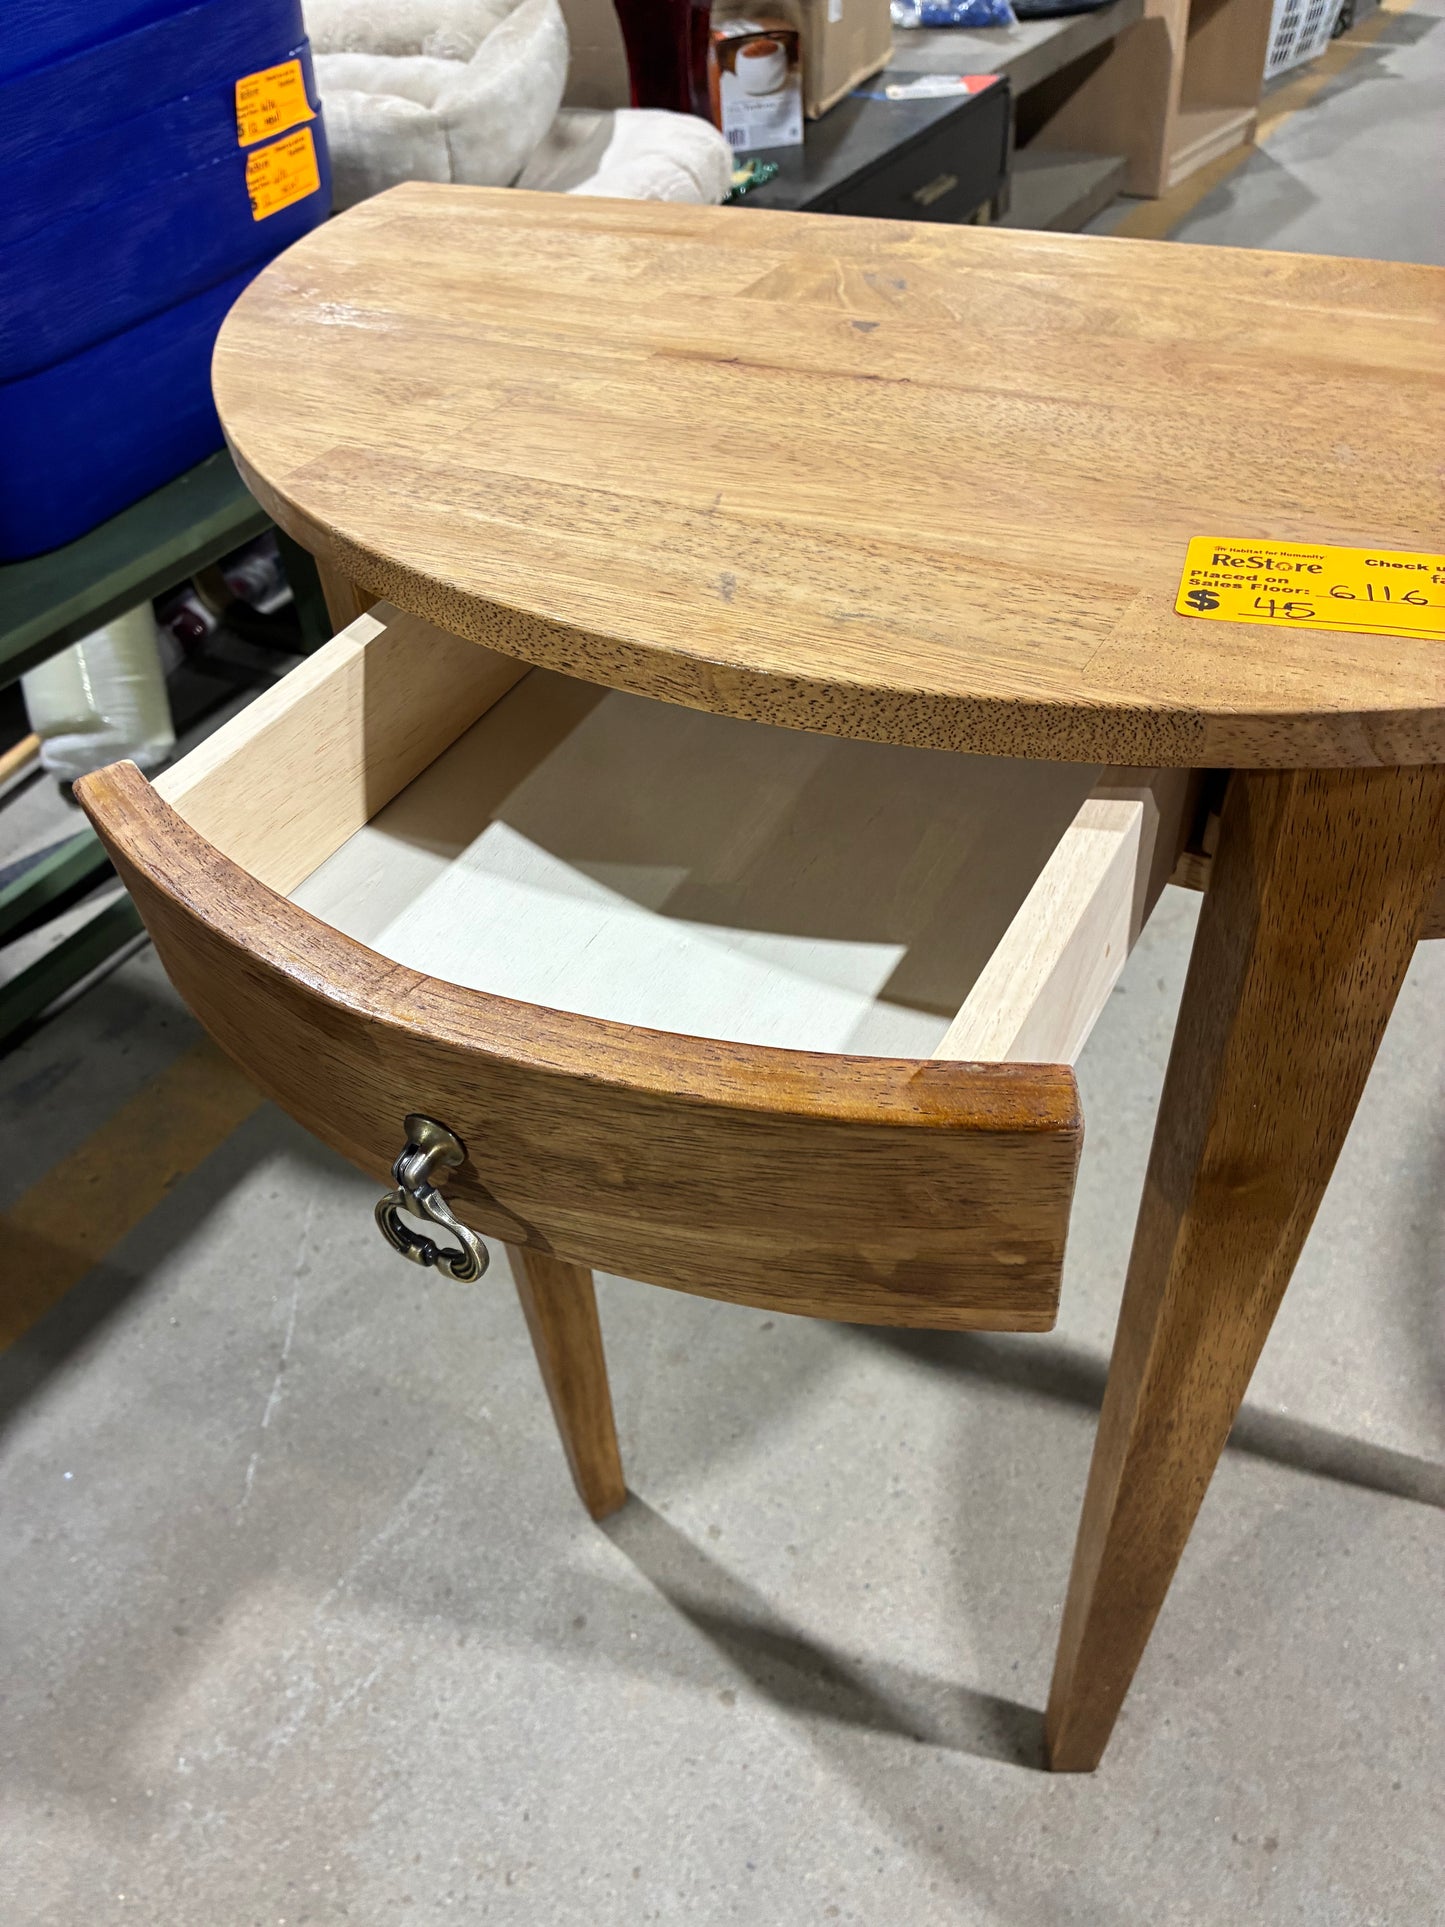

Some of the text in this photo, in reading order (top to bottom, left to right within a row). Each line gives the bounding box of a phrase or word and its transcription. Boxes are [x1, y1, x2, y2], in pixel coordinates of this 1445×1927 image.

[1229, 547, 1263, 556] Habitat
[1280, 551, 1325, 561] Humanity
[1211, 553, 1323, 574] ReStore
[1364, 559, 1430, 571] Check
[1190, 570, 1289, 584] Placed on
[1188, 578, 1243, 589] Sales
[1250, 583, 1310, 595] Floor:
[1184, 589, 1316, 619] $ 45
